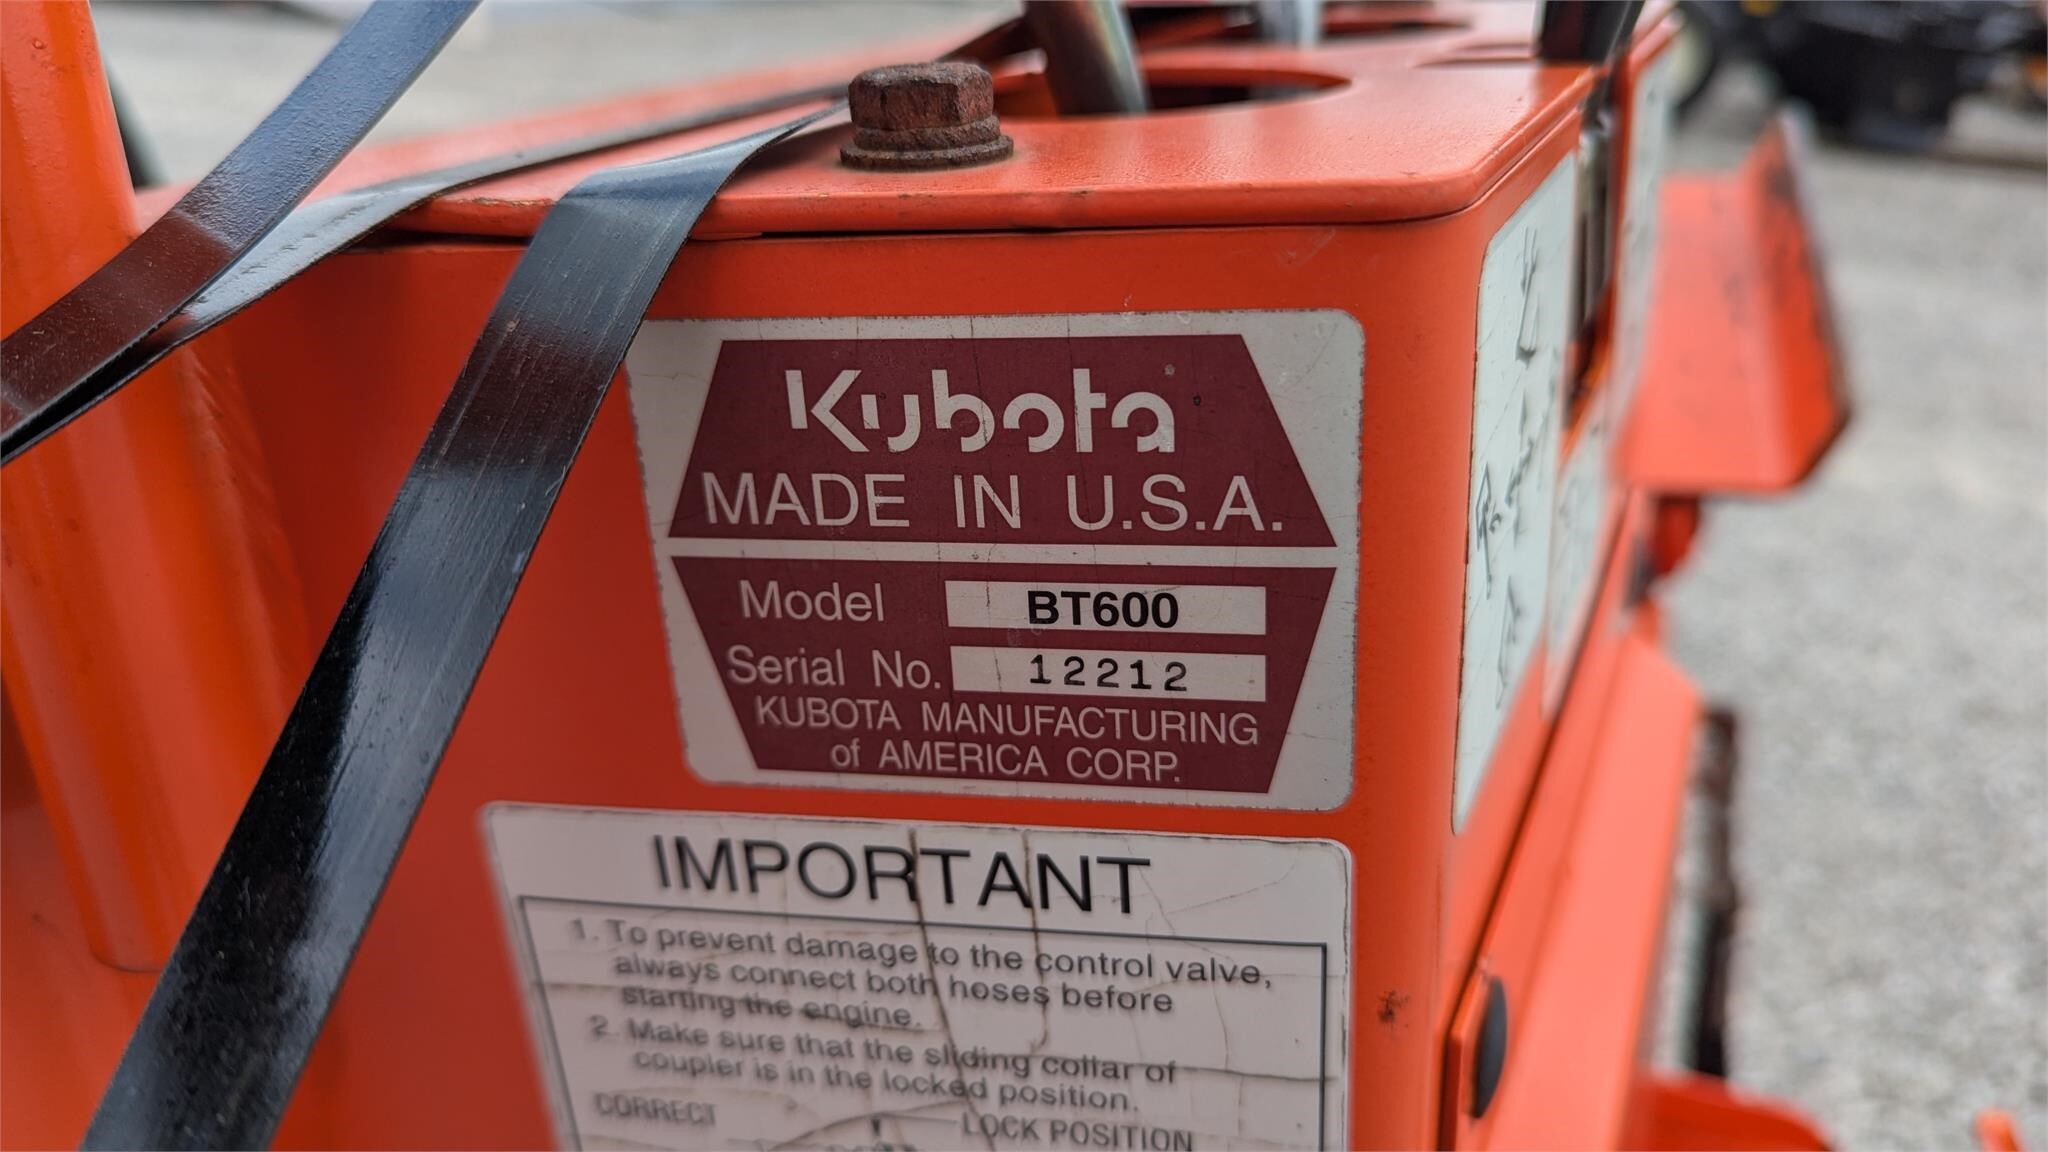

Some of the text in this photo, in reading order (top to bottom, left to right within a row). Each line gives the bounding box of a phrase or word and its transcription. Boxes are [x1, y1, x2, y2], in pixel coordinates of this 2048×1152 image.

[786, 368, 1176, 453] Kubota
[702, 472, 1283, 532] MADE IN U.S.A.
[740, 579, 1179, 628] Model BT600
[727, 644, 1188, 692] Serial No. 12212
[755, 695, 1258, 745] KUBOTA MANUFACTURING
[830, 738, 1180, 782] of AMERICA CORP.
[652, 834, 1151, 916] IMPORTANT
[570, 917, 1272, 989] 1. To prevent damage to the control valve,
[614, 953, 1174, 1013] always connect both hoses before
[621, 985, 922, 1029] starting the engine.
[628, 1017, 709, 1045] Make
[718, 1030, 785, 1053] sure
[794, 1032, 855, 1059] that
[863, 1038, 914, 1064] the
[925, 1042, 1031, 1079] sliding
[1041, 1053, 1134, 1081] collar
[1145, 1060, 1177, 1085] of
[595, 1091, 718, 1126] CORRECT
[633, 1050, 1139, 1112] coupler is in the locked position.
[961, 1110, 1193, 1152] LOCK POSITION
